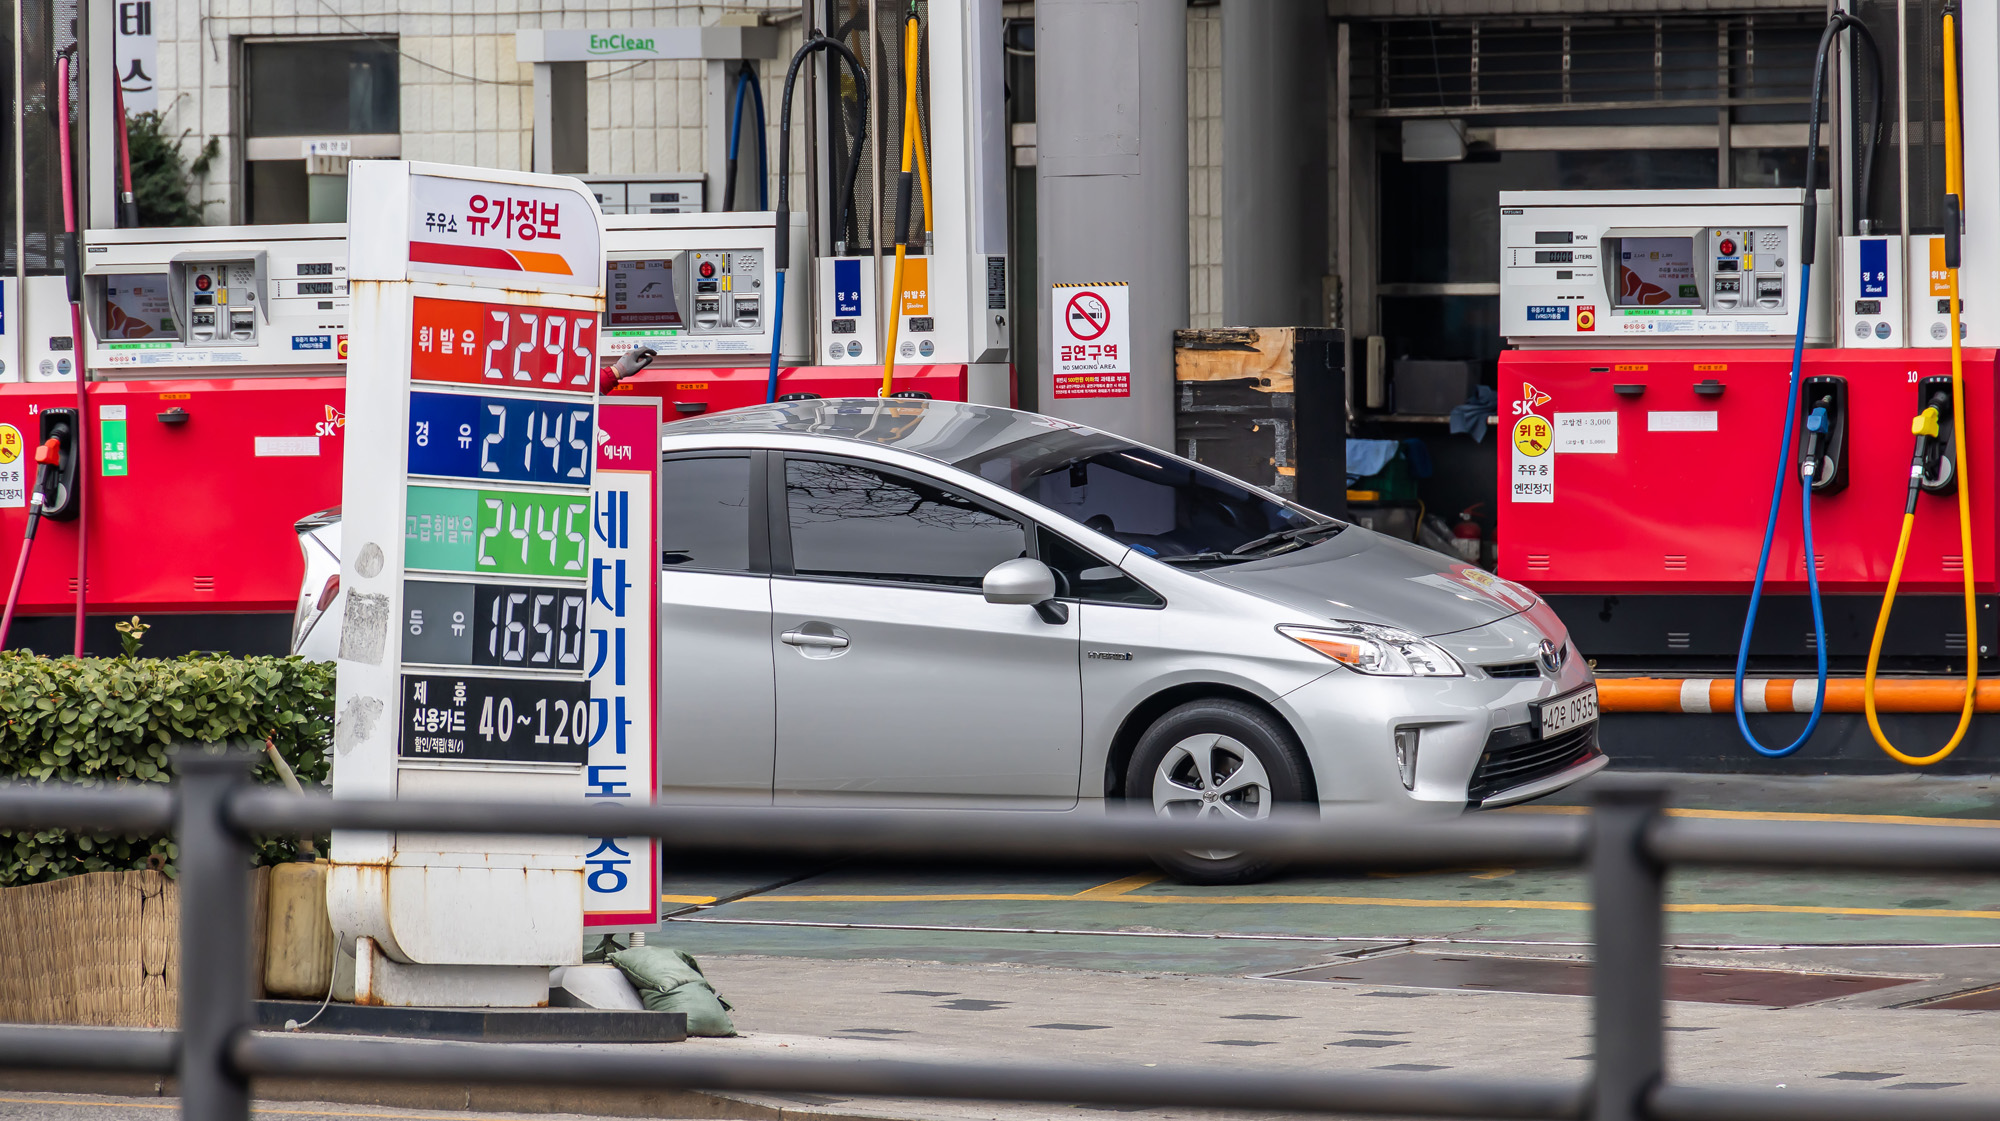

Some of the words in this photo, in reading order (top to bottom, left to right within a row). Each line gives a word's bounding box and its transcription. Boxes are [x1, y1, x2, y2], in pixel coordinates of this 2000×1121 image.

[590, 34, 655, 50] EnClean
[426, 212, 458, 233] 주유소
[466, 194, 561, 241] 유가정보
[1931, 270, 1950, 280] 휘발
[904, 290, 926, 299] 휘발유
[484, 310, 594, 385] 2295
[1061, 344, 1117, 361] 금연구역
[1907, 371, 1918, 383] 10
[29, 404, 38, 415] 14
[1512, 400, 1533, 415] SK
[315, 422, 335, 436] SK
[1590, 418, 1611, 426] 3,000
[0, 433, 16, 445] 험
[480, 404, 590, 477] 2145
[1518, 464, 1537, 476] 주유
[1539, 464, 1548, 476] 중
[1514, 483, 1552, 495] 엔진정지
[405, 514, 474, 544] 고급휘발유
[478, 498, 587, 571] 2445
[489, 593, 584, 664] 1650
[1088, 651, 1125, 660] HYBRID
[1547, 706, 1566, 731] 42우
[1570, 694, 1594, 723] 0935
[413, 708, 466, 733] 신용카드
